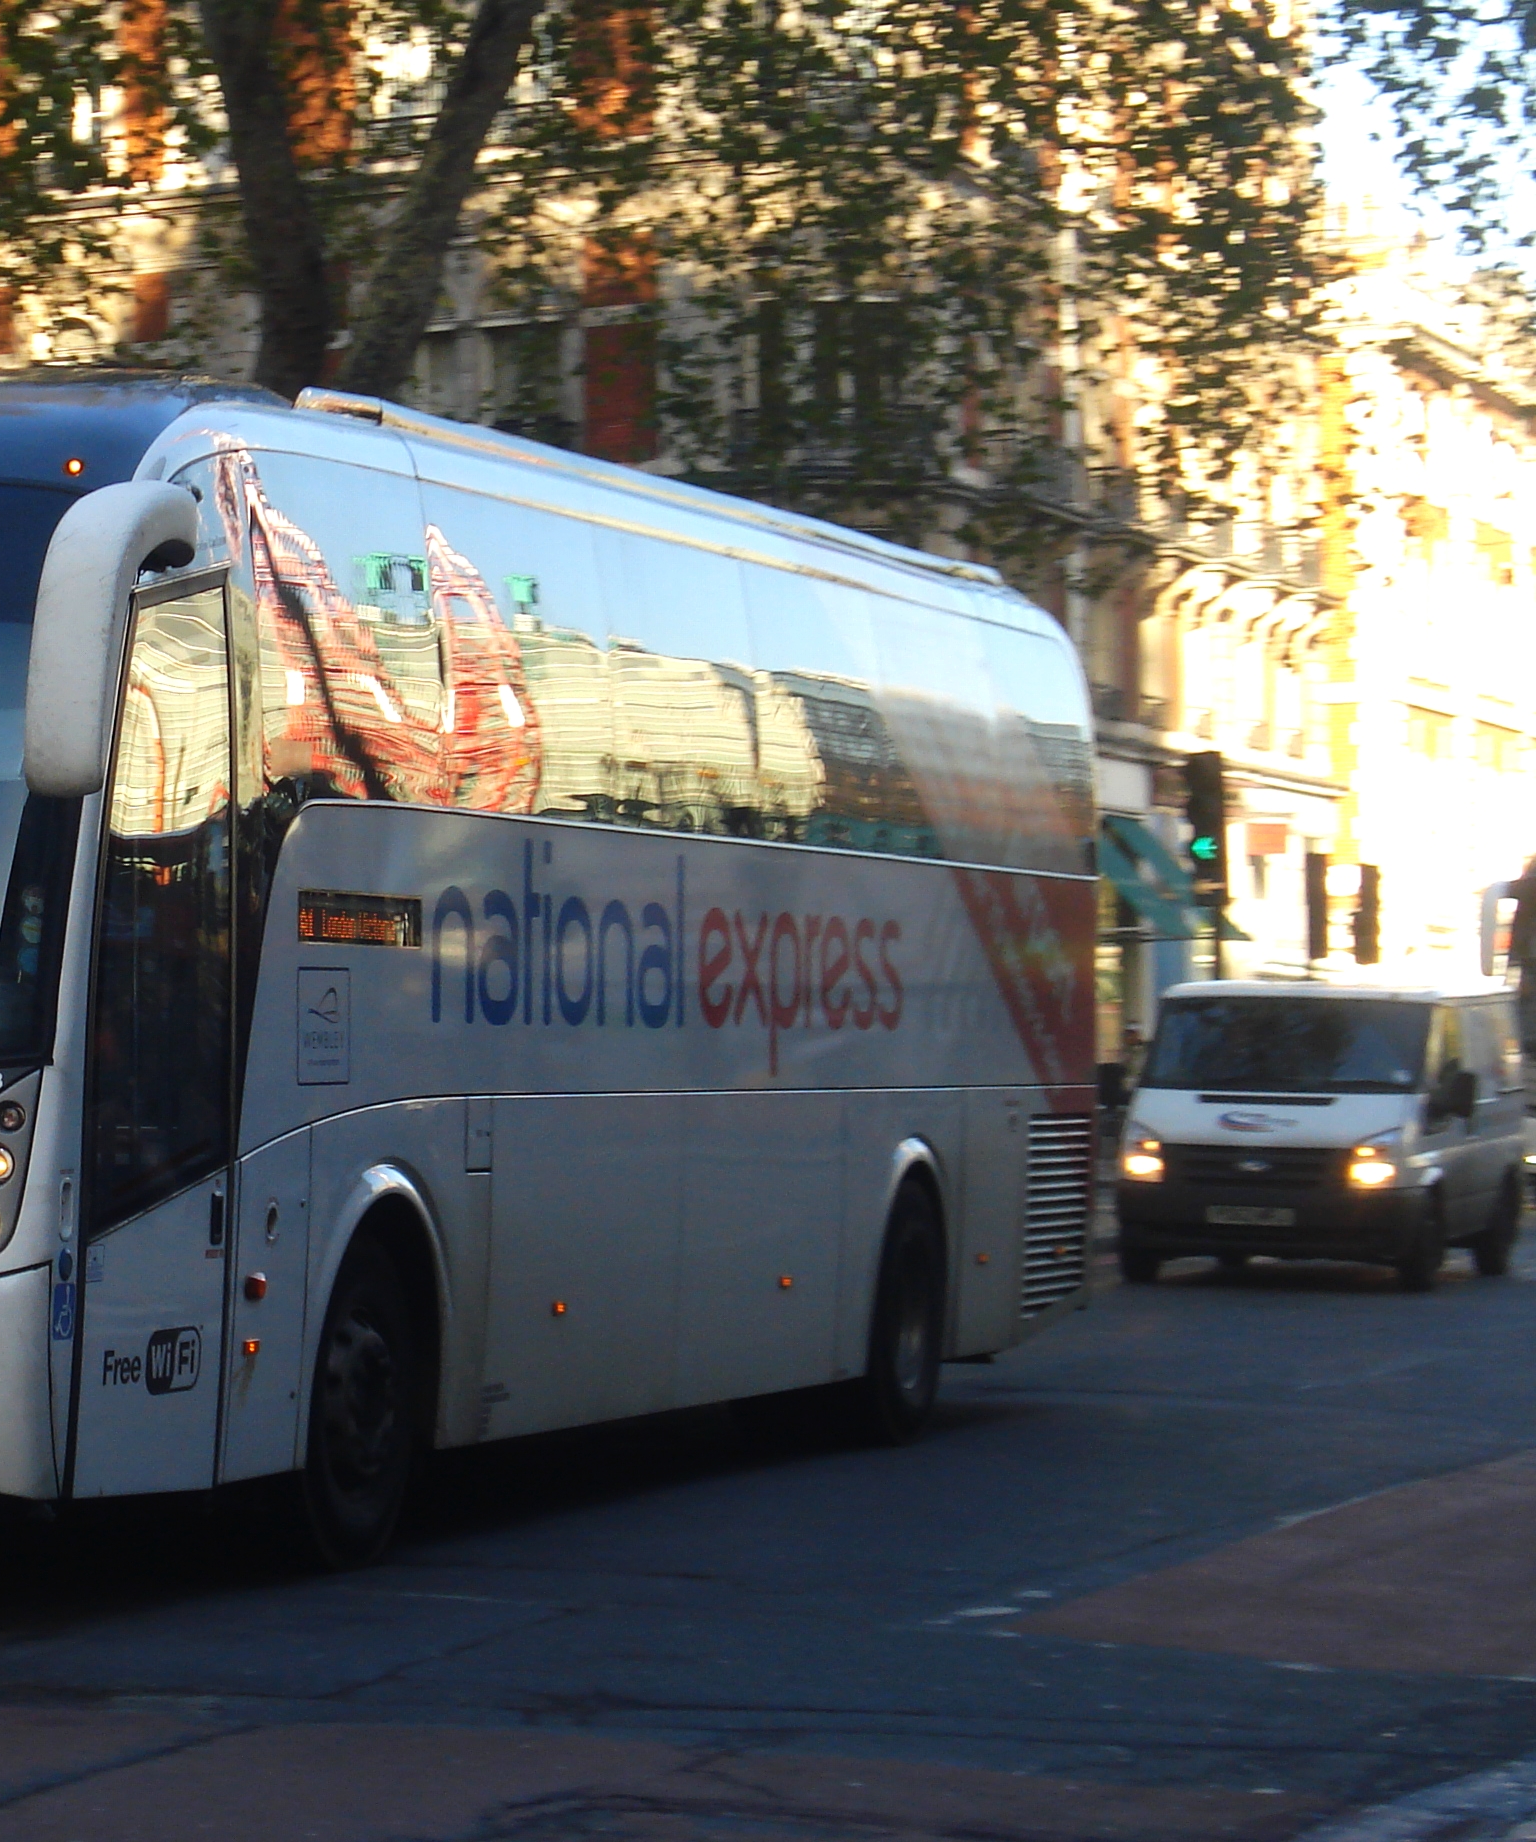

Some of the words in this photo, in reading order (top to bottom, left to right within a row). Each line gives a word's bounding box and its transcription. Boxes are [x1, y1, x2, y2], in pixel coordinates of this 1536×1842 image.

[430, 837, 686, 1028] national
[697, 906, 904, 1077] express
[102, 1349, 142, 1386] Free
